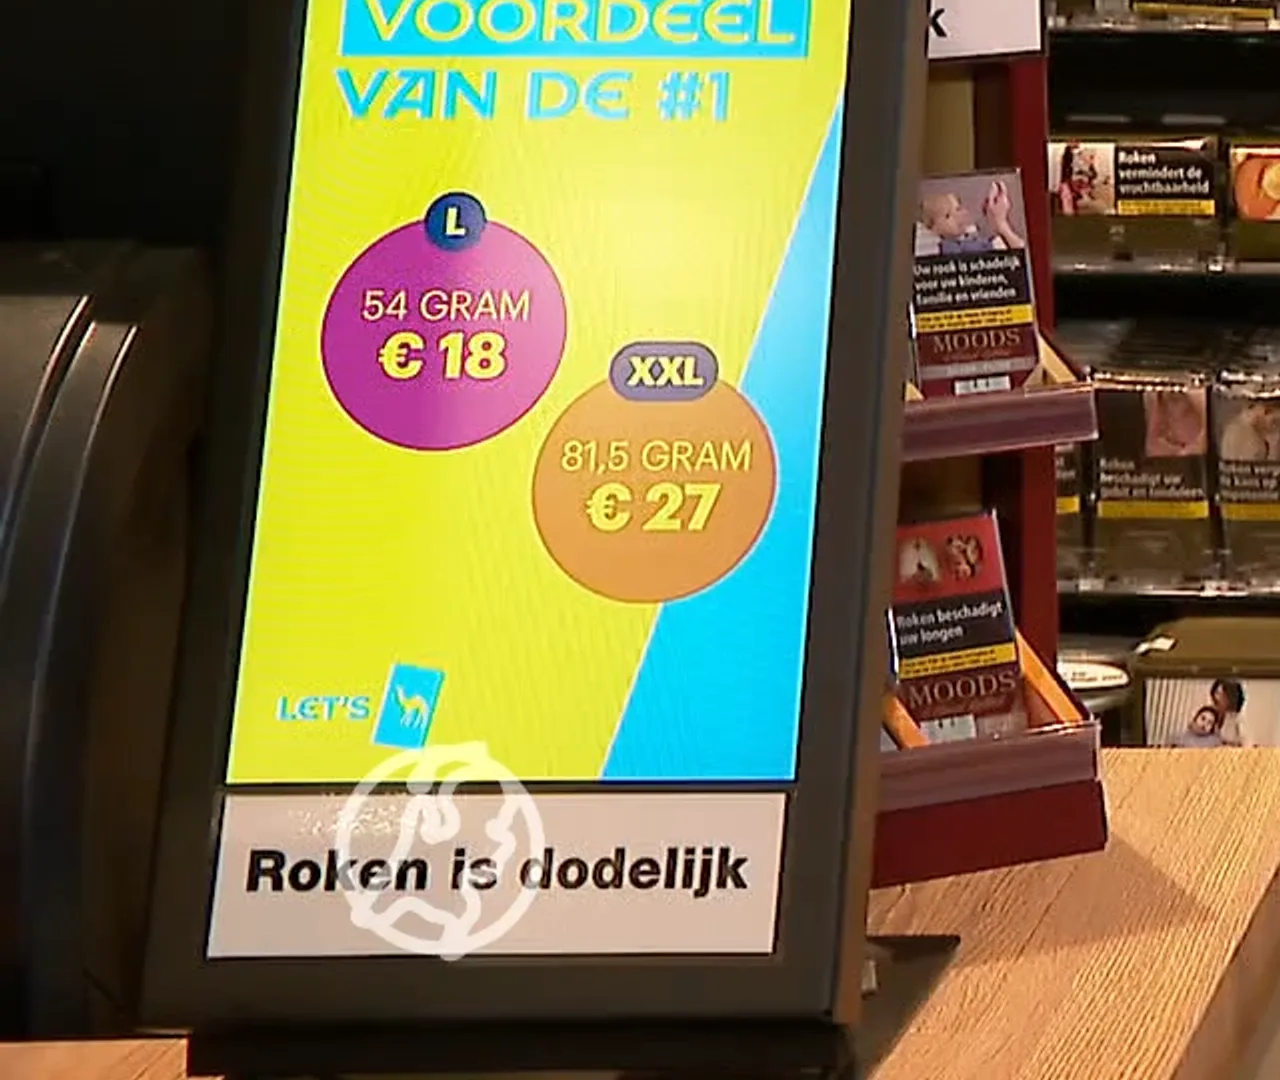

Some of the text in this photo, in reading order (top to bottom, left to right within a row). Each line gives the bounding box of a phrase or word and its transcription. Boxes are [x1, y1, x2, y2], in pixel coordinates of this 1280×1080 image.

[335, 69, 731, 121] VAN DE #1
[446, 208, 465, 236] L
[362, 289, 530, 322] 54 GRAM
[378, 332, 505, 380] € 18
[934, 329, 1020, 353] MOODS
[627, 356, 703, 387] XXL
[561, 440, 751, 475] 81,5 GRAM
[586, 482, 721, 532] € 27
[937, 602, 1003, 621] beschadigt
[901, 626, 963, 645] uw longen
[909, 671, 1016, 708] MOODS
[276, 694, 370, 721] LET'S
[246, 847, 748, 898] Roken is dodelijk
